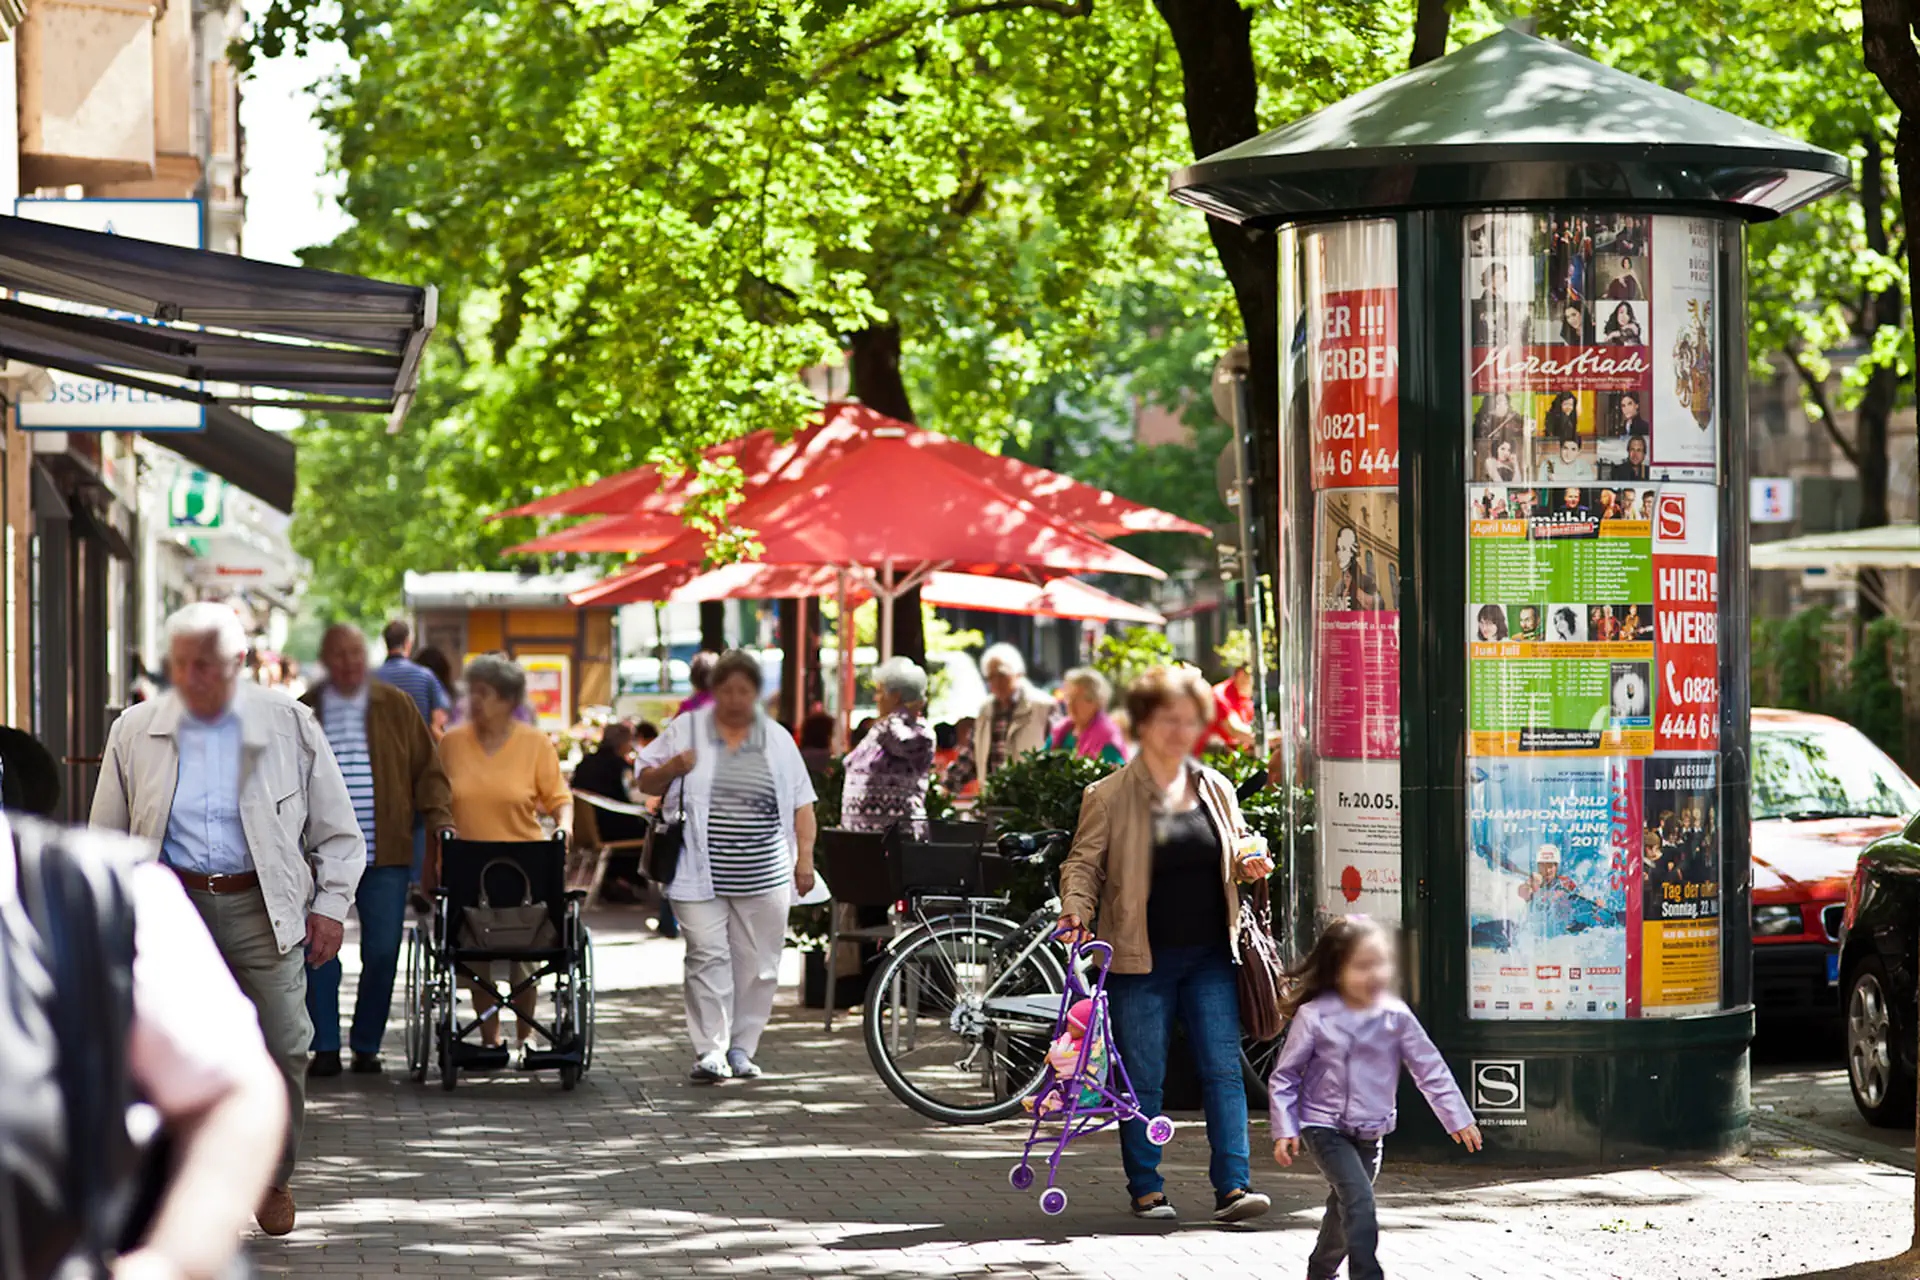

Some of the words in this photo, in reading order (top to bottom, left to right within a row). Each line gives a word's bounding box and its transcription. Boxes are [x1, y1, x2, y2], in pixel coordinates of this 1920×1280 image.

[1359, 305, 1384, 337] !!!
[1322, 413, 1380, 440] 0821-
[1340, 449, 1352, 475] 6
[1473, 522, 1499, 535] April
[1501, 521, 1521, 533] Mai
[1660, 498, 1685, 537] S
[1659, 567, 1707, 601] HIER
[1659, 712, 1696, 740] 444
[1699, 713, 1710, 740] 6
[1338, 791, 1351, 808] Fr.
[1353, 792, 1399, 809] 20.05.
[1549, 795, 1609, 807] WORLD
[1470, 808, 1609, 821] CHAMPIONSHIPS
[1502, 822, 1524, 833] 11.
[1541, 822, 1563, 833] 13.
[1566, 822, 1609, 834] JUNE
[1661, 881, 1682, 902] Tag
[1684, 881, 1699, 898] der
[1661, 901, 1699, 918] Sonntag,
[1478, 1065, 1519, 1107] S
